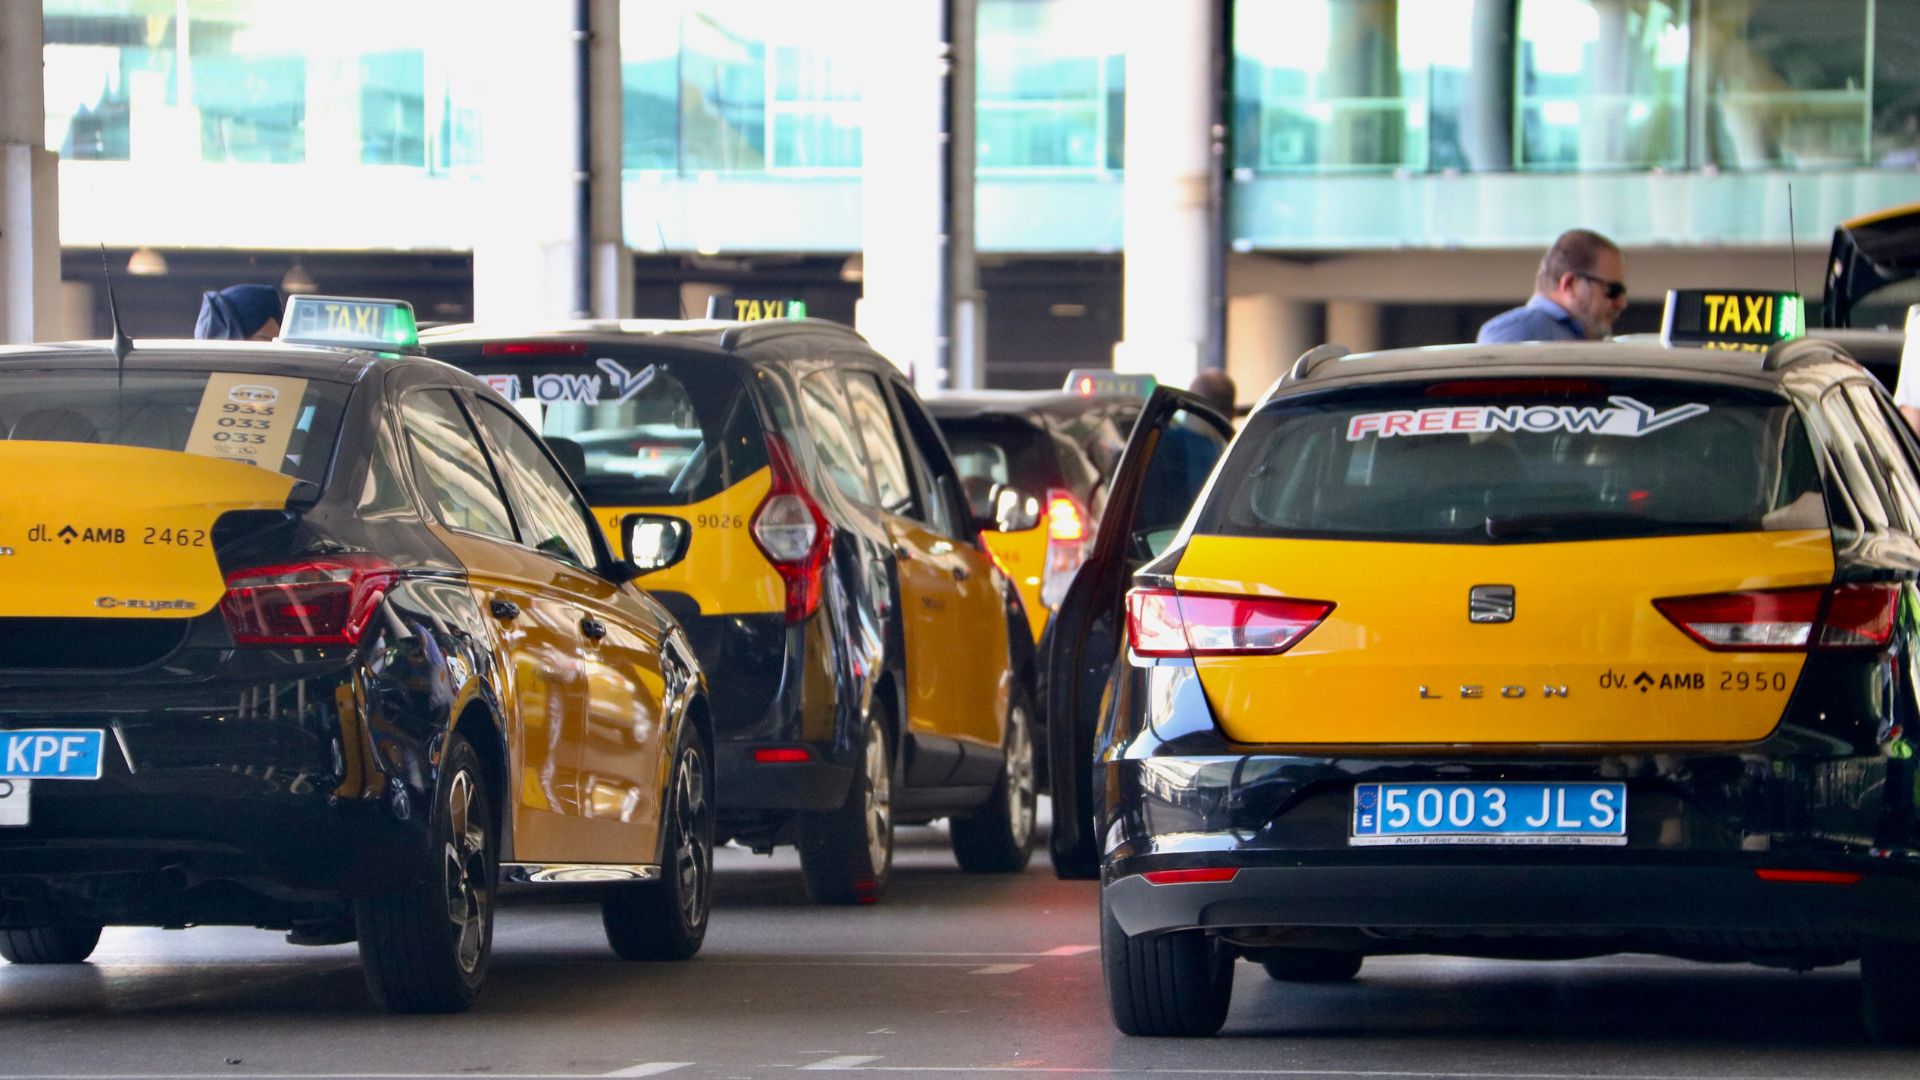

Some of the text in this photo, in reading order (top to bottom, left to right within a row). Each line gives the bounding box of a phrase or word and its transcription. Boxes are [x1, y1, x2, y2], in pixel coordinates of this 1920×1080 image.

[325, 304, 379, 337] TAXI
[734, 299, 784, 321] TAXI
[1704, 295, 1773, 333] TAXI
[223, 403, 275, 415] 933
[217, 417, 270, 430] 033
[212, 432, 266, 444] 033
[697, 514, 743, 528] 9026
[28, 524, 206, 547] dl. AMB 2462
[1600, 669, 1786, 691] dv. AMB 2950
[1419, 684, 1568, 699] LEON
[6, 735, 86, 772] KPF
[1386, 787, 1616, 827] 5003 JLS
[1361, 815, 1373, 826] E
